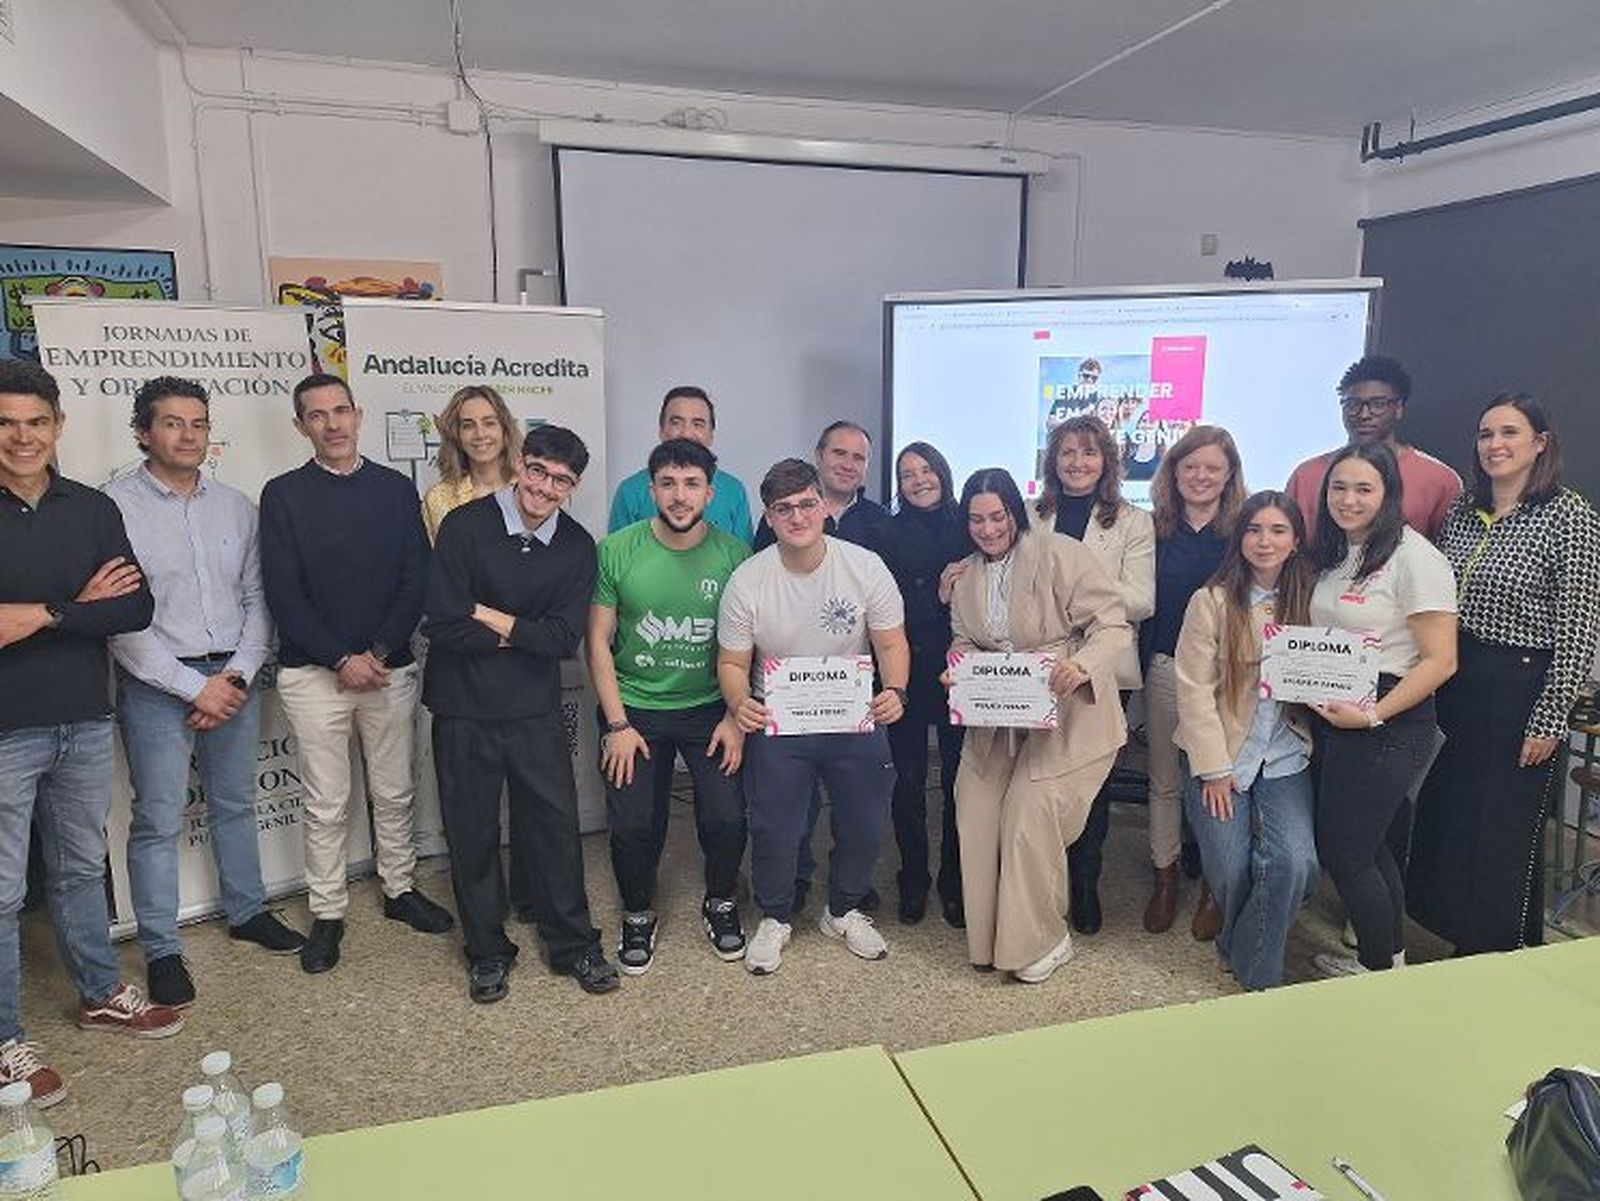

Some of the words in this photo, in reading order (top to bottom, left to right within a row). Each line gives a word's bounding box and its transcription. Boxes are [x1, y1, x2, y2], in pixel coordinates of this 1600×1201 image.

[102, 325, 218, 343] JORNADAS
[225, 328, 253, 343] DE
[45, 347, 307, 370] EMPRENDIMIENTO
[363, 353, 487, 376] Andalucía
[491, 357, 590, 379] Acredita
[71, 377, 90, 396] Y
[100, 373, 292, 397] ORACIÓN
[1055, 382, 1174, 400] EMPRENDER
[1287, 639, 1352, 655] DIPLOMA
[789, 669, 848, 682] DIPLOMA
[972, 664, 1032, 677] DIPLOMA
